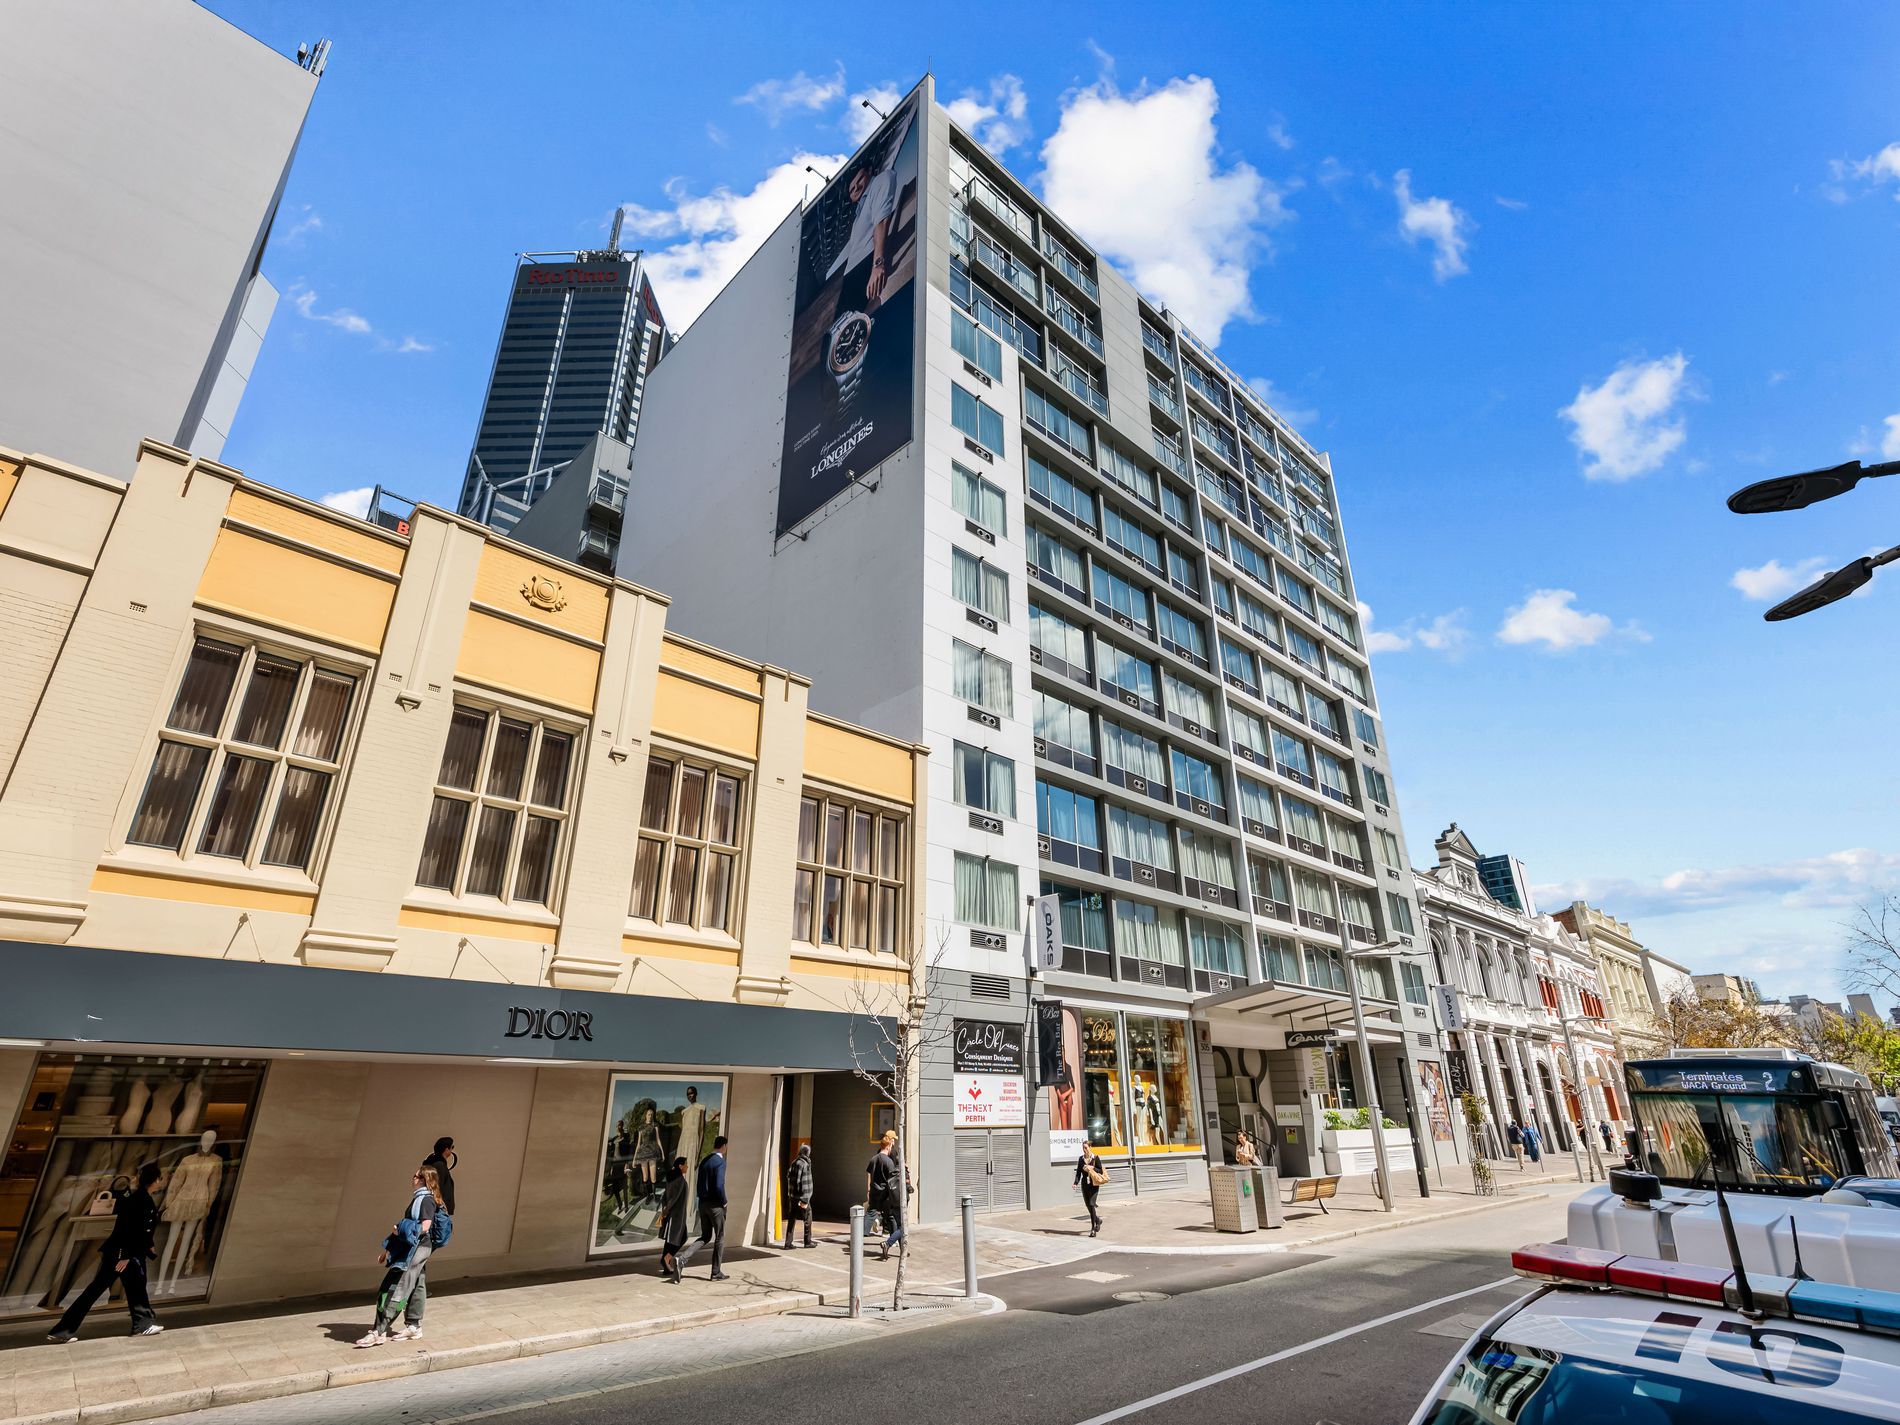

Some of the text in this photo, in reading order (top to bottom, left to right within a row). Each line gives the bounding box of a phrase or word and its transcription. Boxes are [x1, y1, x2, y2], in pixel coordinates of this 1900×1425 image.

[528, 269, 564, 285] Rio
[811, 421, 874, 479] LONGINES
[1045, 912, 1054, 966] OAKS
[504, 1006, 594, 1042] DIOR
[1445, 994, 1456, 1028] OAKS
[957, 1028, 983, 1054] Circle
[1679, 1072, 1776, 1091] Terminates 2
[1681, 1081, 1747, 1090] WACA Ground
